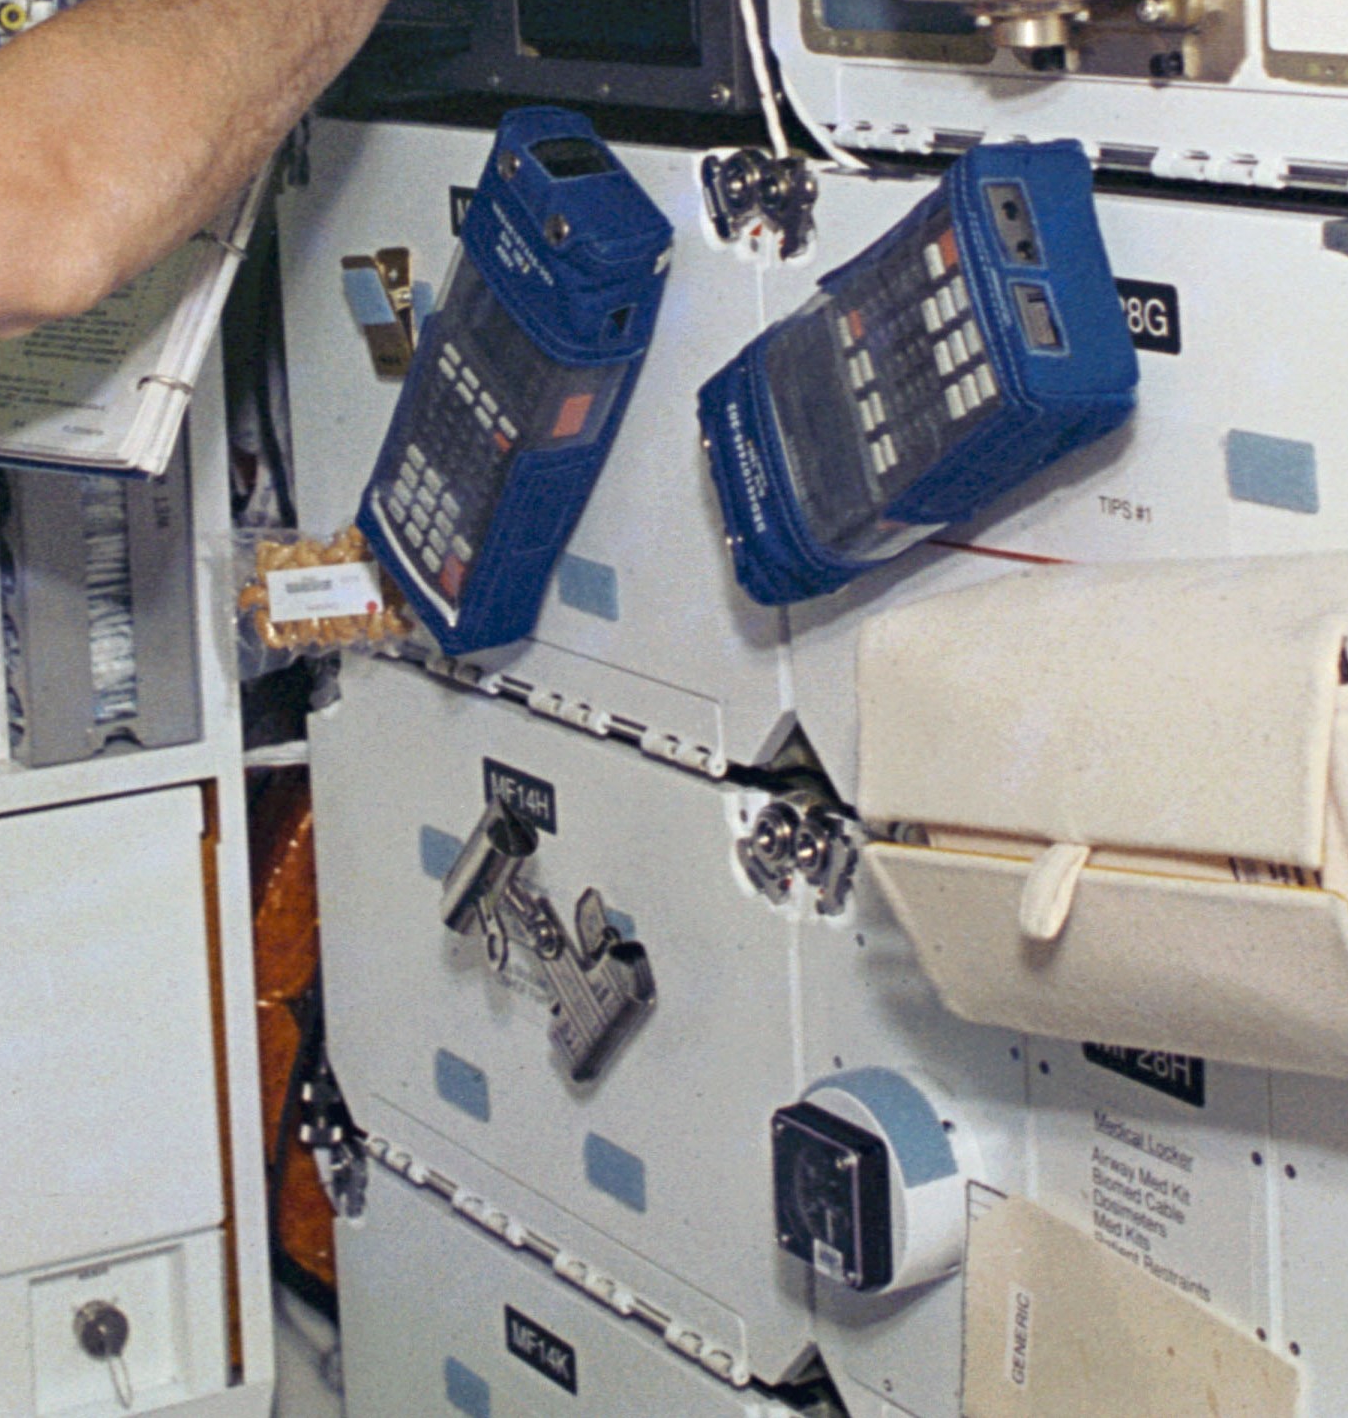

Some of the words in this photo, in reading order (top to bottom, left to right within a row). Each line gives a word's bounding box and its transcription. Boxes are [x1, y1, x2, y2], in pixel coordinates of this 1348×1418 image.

[1117, 295, 1170, 338] 8G
[1097, 494, 1133, 521] TIPS
[1092, 1166, 1142, 1204] Biomed
[1145, 1191, 1186, 1225] Cable
[1138, 1167, 1169, 1195] Med
[1093, 1209, 1123, 1237] Med
[1125, 1225, 1151, 1251] Kits
[1011, 1291, 1031, 1385] GENERIC
